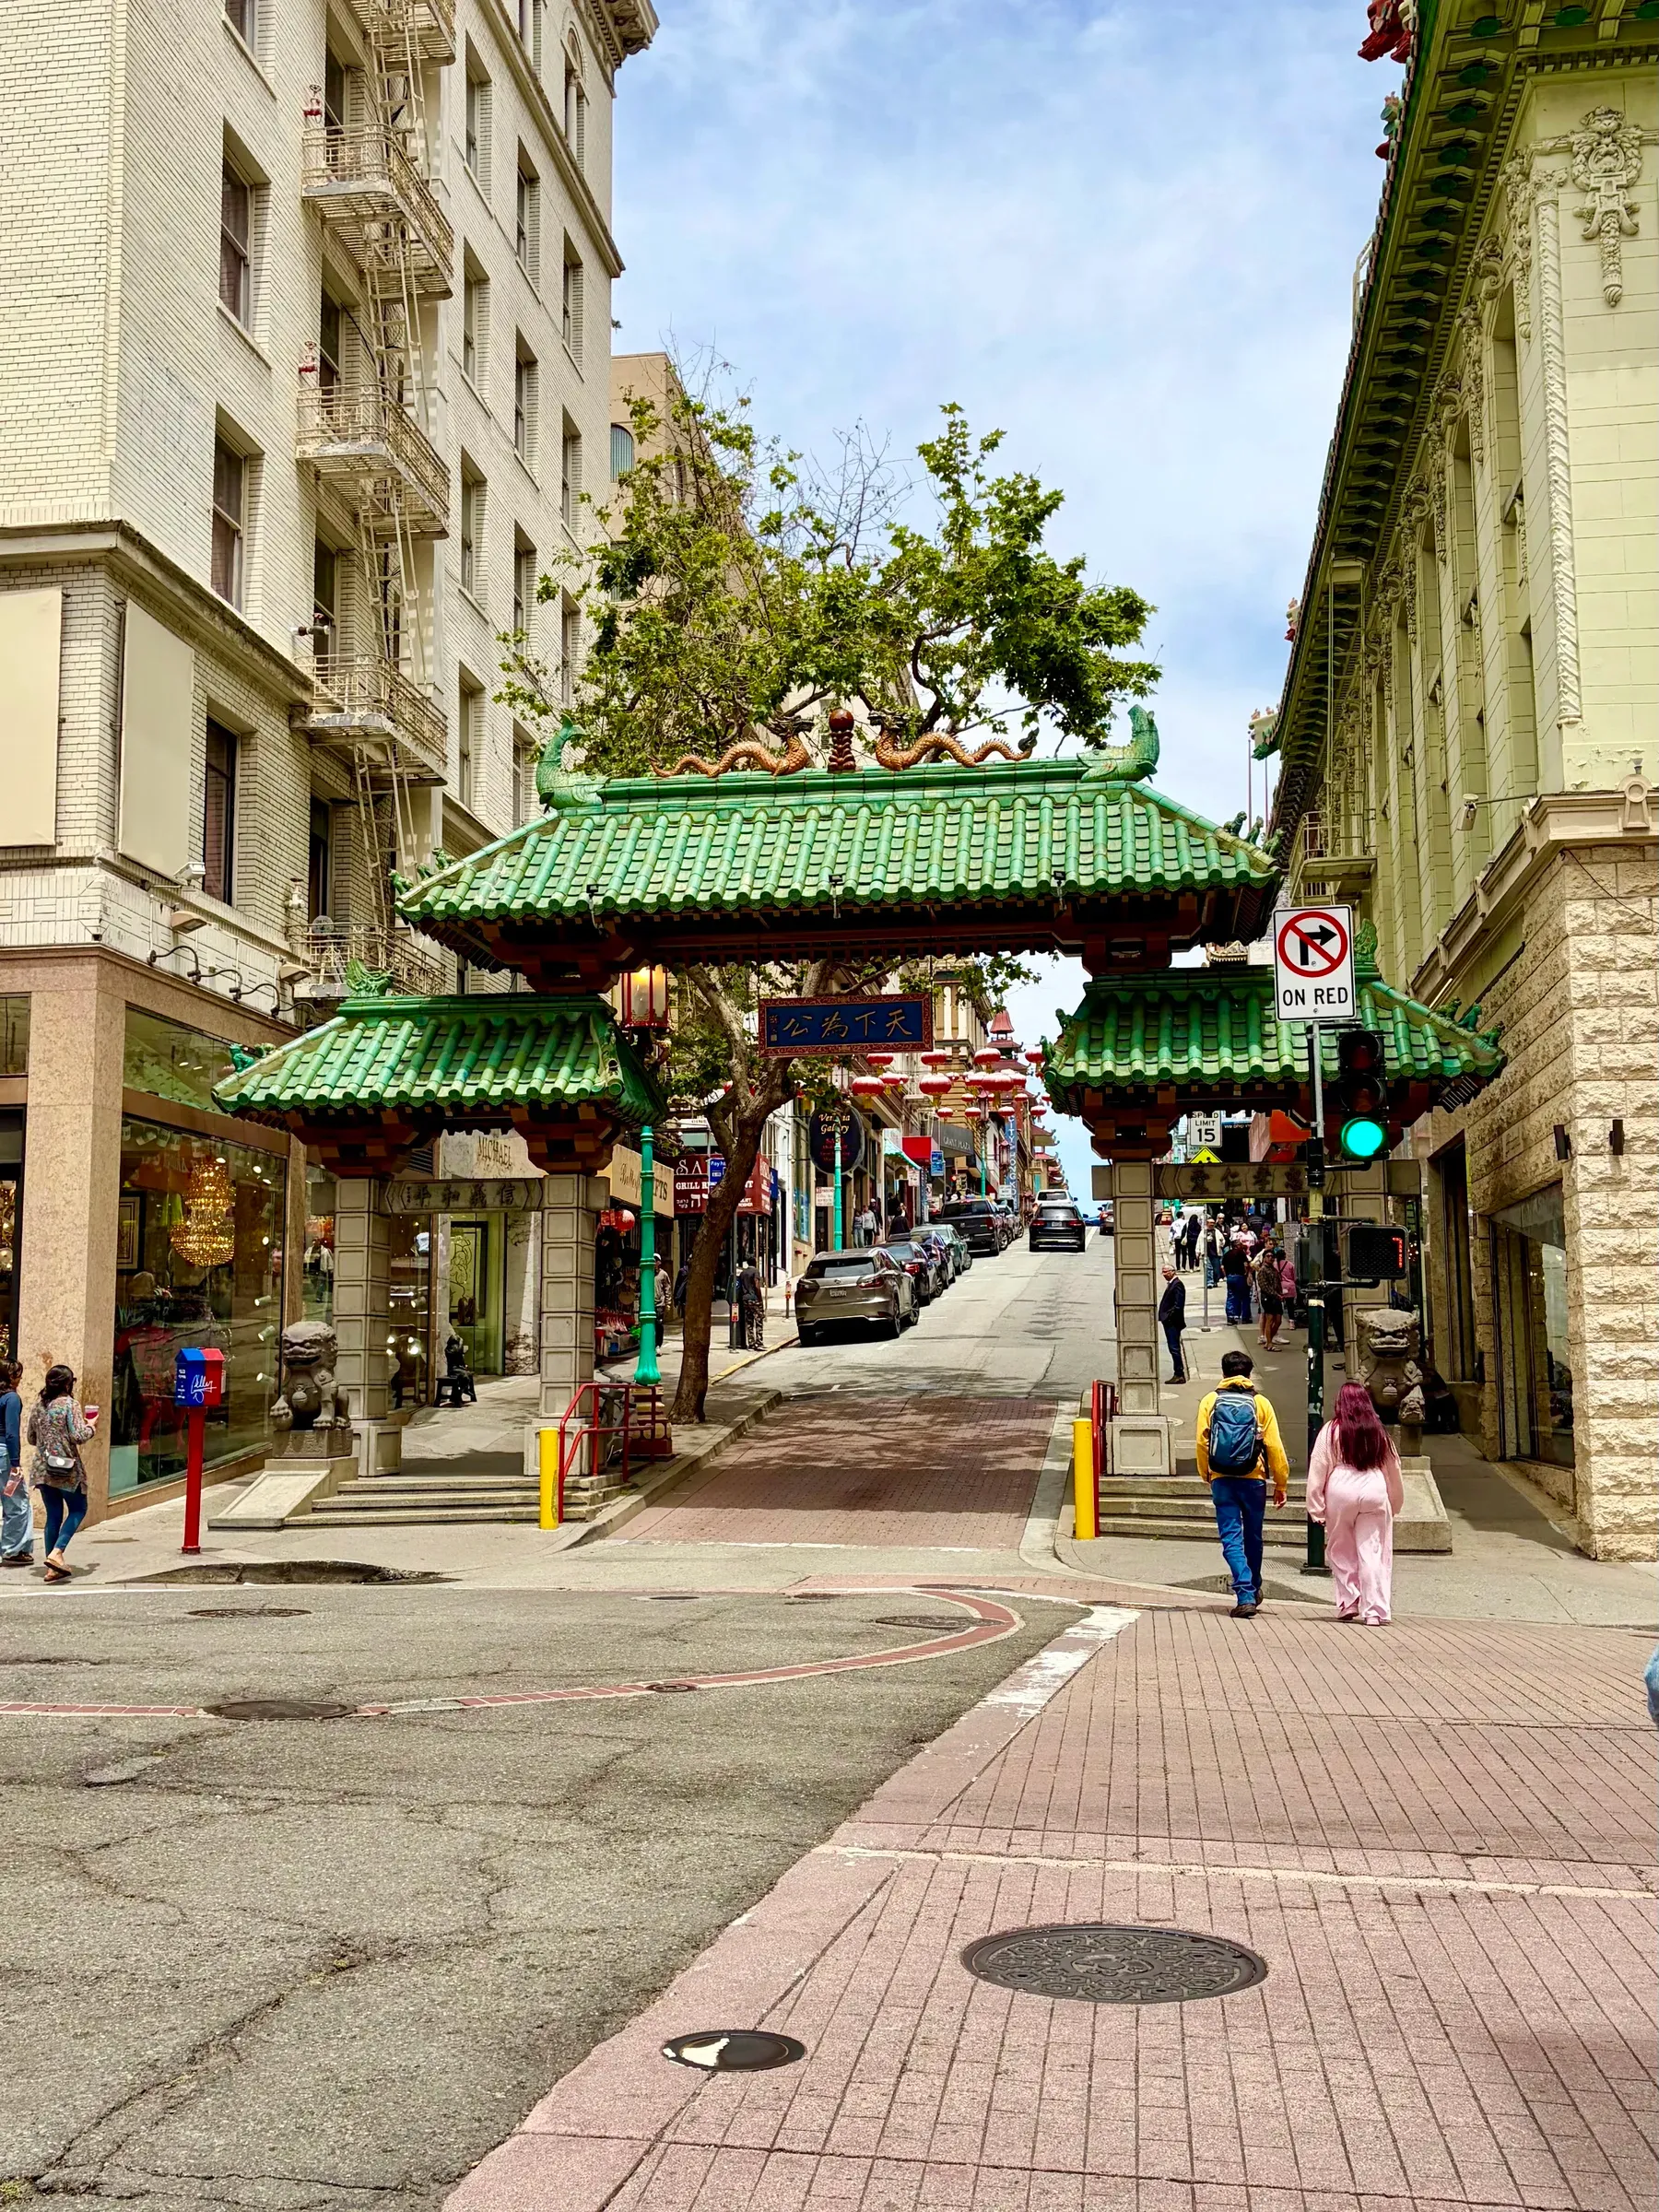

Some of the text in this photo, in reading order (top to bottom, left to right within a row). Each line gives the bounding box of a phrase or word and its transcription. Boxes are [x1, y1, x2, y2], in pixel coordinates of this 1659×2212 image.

[1283, 987, 1348, 1006] ON RED
[1197, 1128, 1216, 1142] 15
[676, 1182, 700, 1190] GRILL
